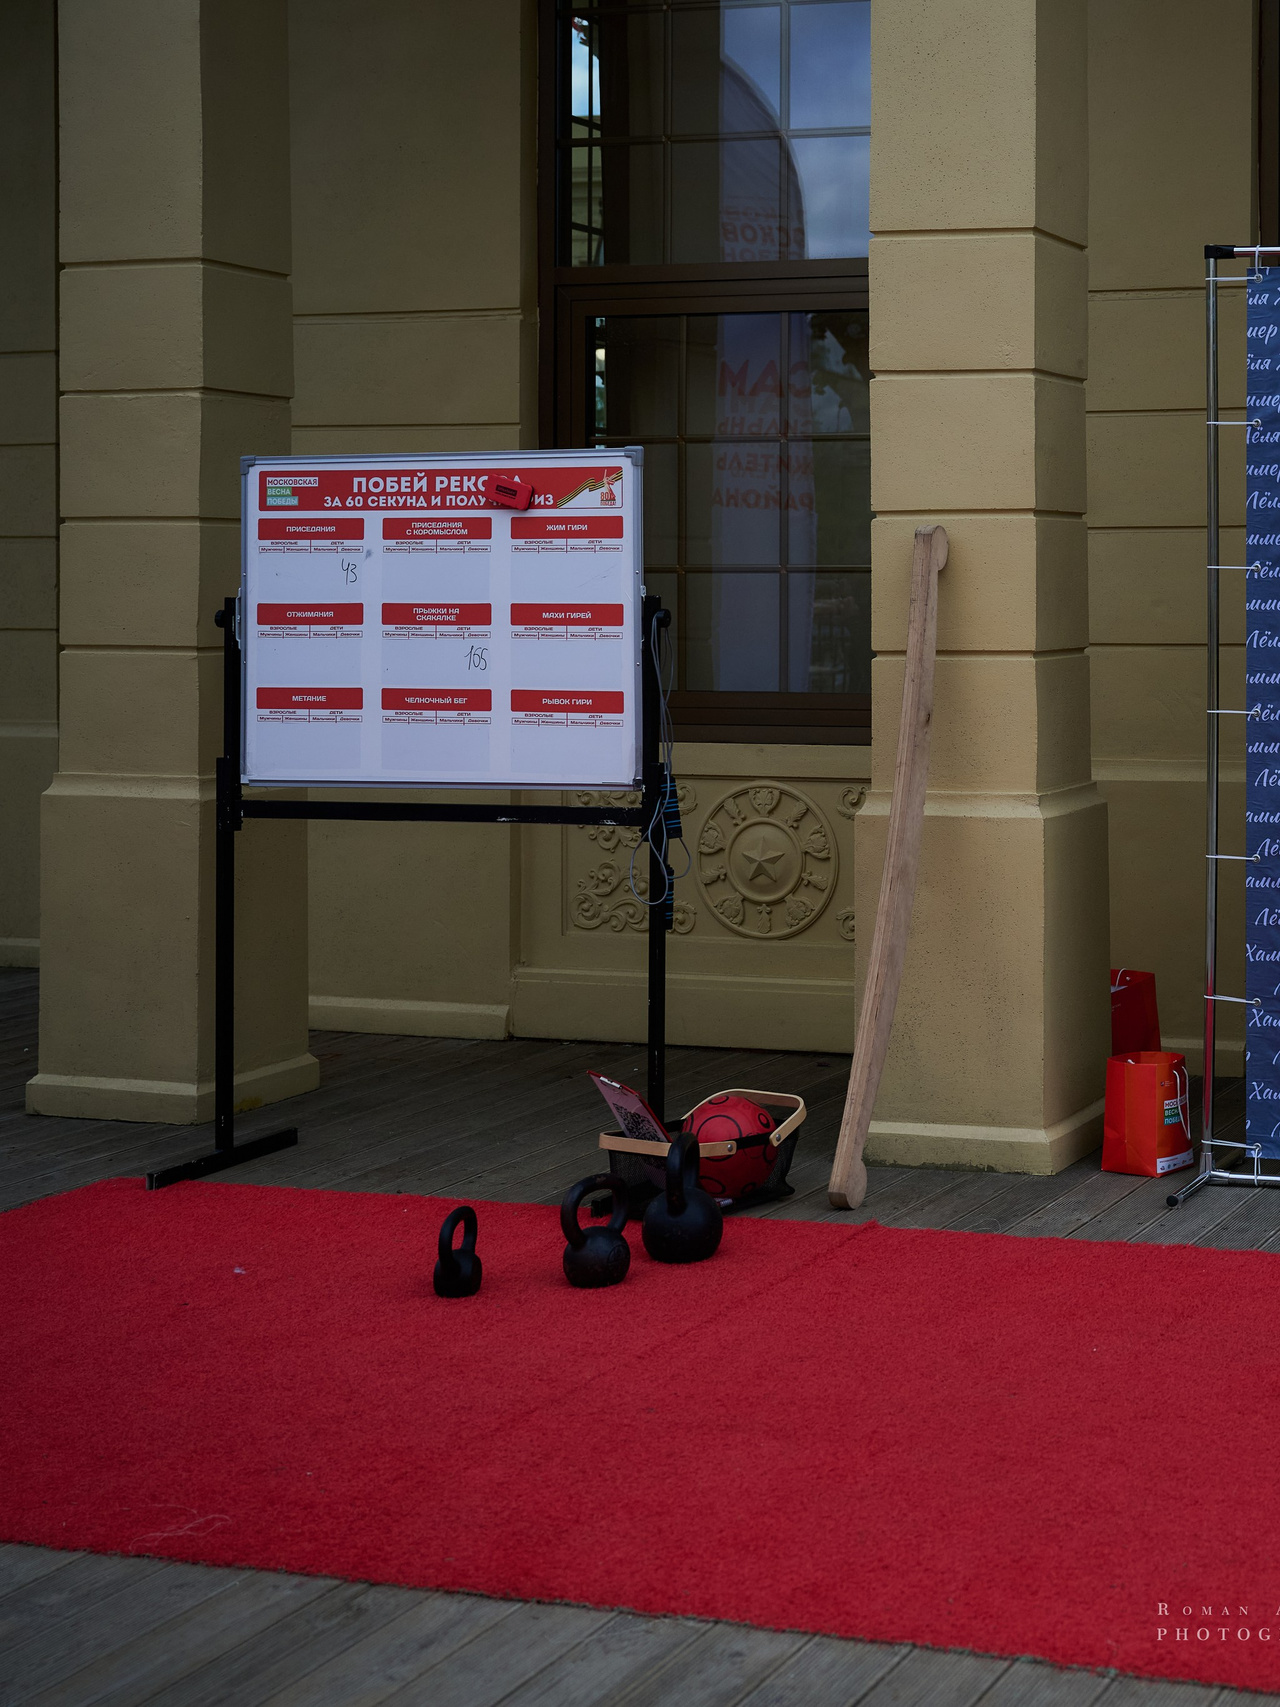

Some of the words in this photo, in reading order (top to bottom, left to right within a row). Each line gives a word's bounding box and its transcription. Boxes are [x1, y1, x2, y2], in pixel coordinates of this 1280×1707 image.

[267, 478, 318, 486] МОСКОВСКАЯ
[353, 472, 427, 493] ПОБЕЙ
[267, 497, 298, 506] ПОБЕДЫ
[324, 496, 342, 508] ЗА
[345, 496, 363, 507] 60
[367, 495, 427, 508] СЕКУНД
[431, 495, 441, 507] И
[413, 528, 468, 536] КОРОМЫСЛОМ
[341, 558, 358, 586] 43
[412, 607, 447, 615] ПРЫЖКИ
[566, 611, 592, 619] ГИРЕЙ
[464, 645, 488, 671] 165
[404, 696, 452, 704] ЧЕЛНОЧНЫЙ
